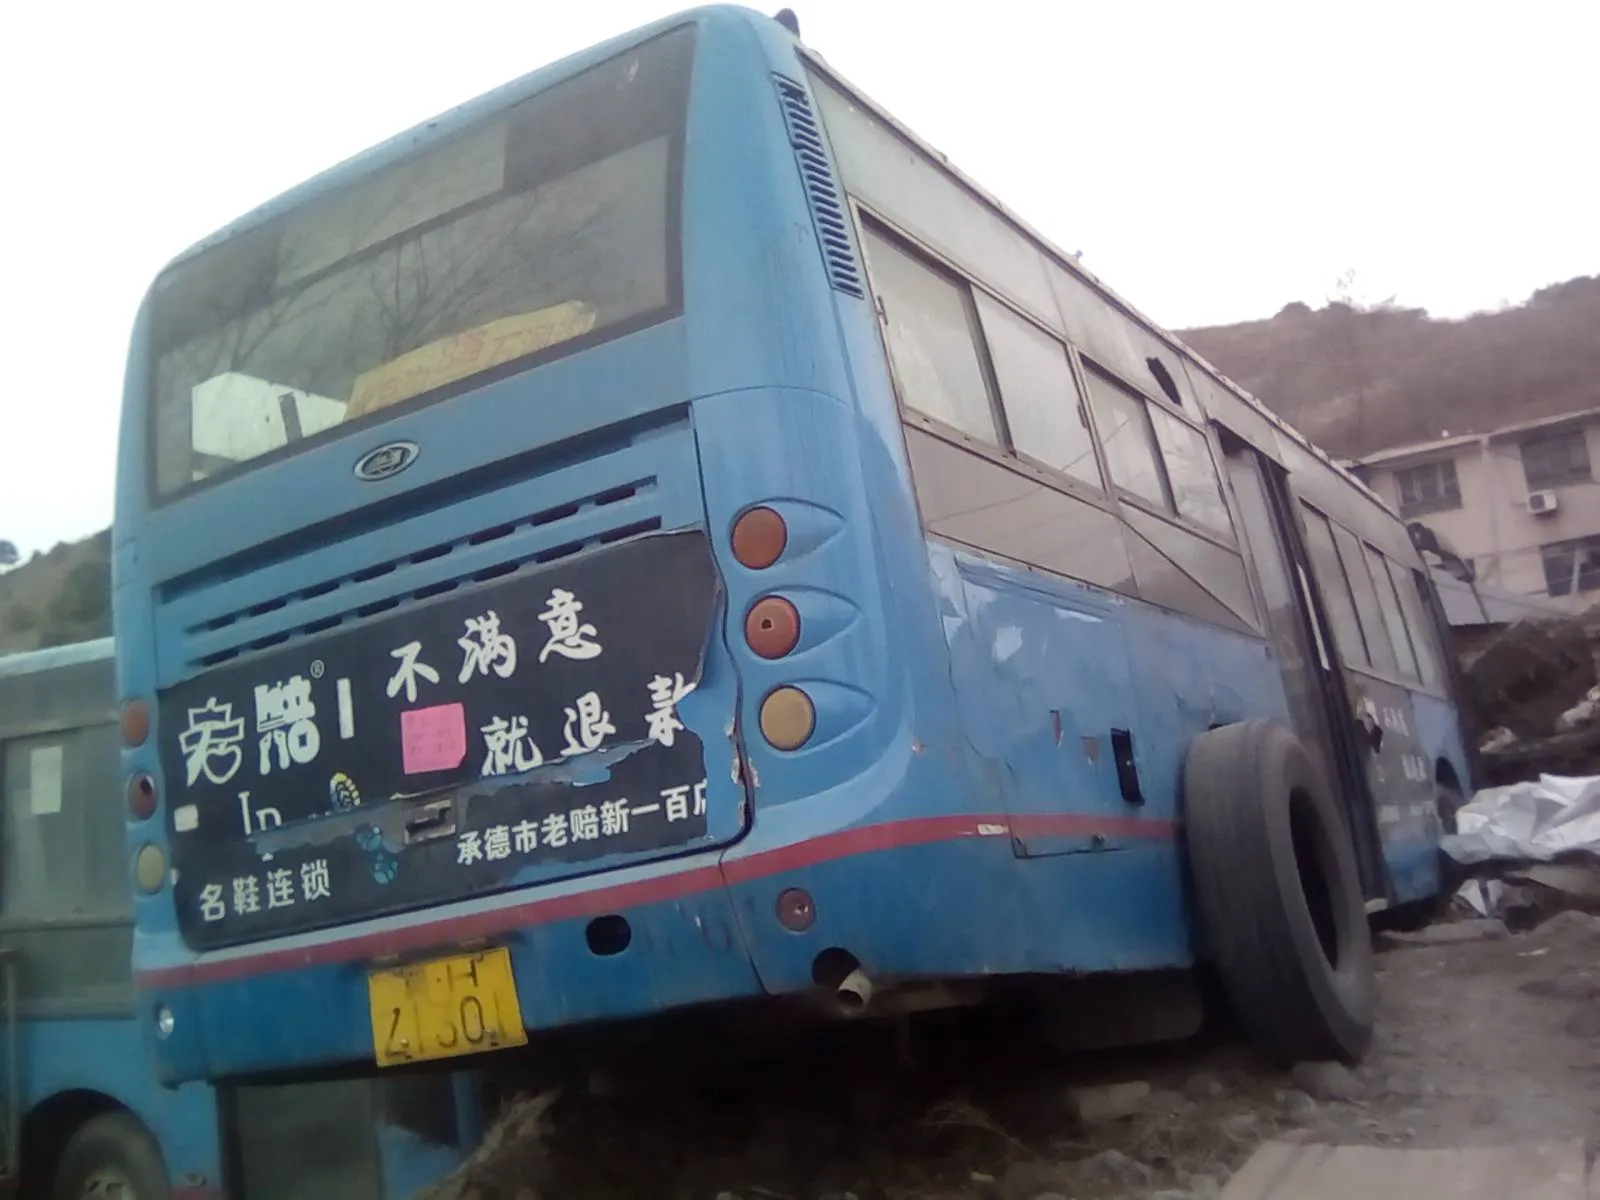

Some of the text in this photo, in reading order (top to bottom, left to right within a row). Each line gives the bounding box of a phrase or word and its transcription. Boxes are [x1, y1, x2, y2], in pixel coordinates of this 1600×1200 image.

[386, 588, 602, 703] 不满意
[479, 673, 698, 776] 就退款
[199, 859, 332, 922] 名鞋连锁
